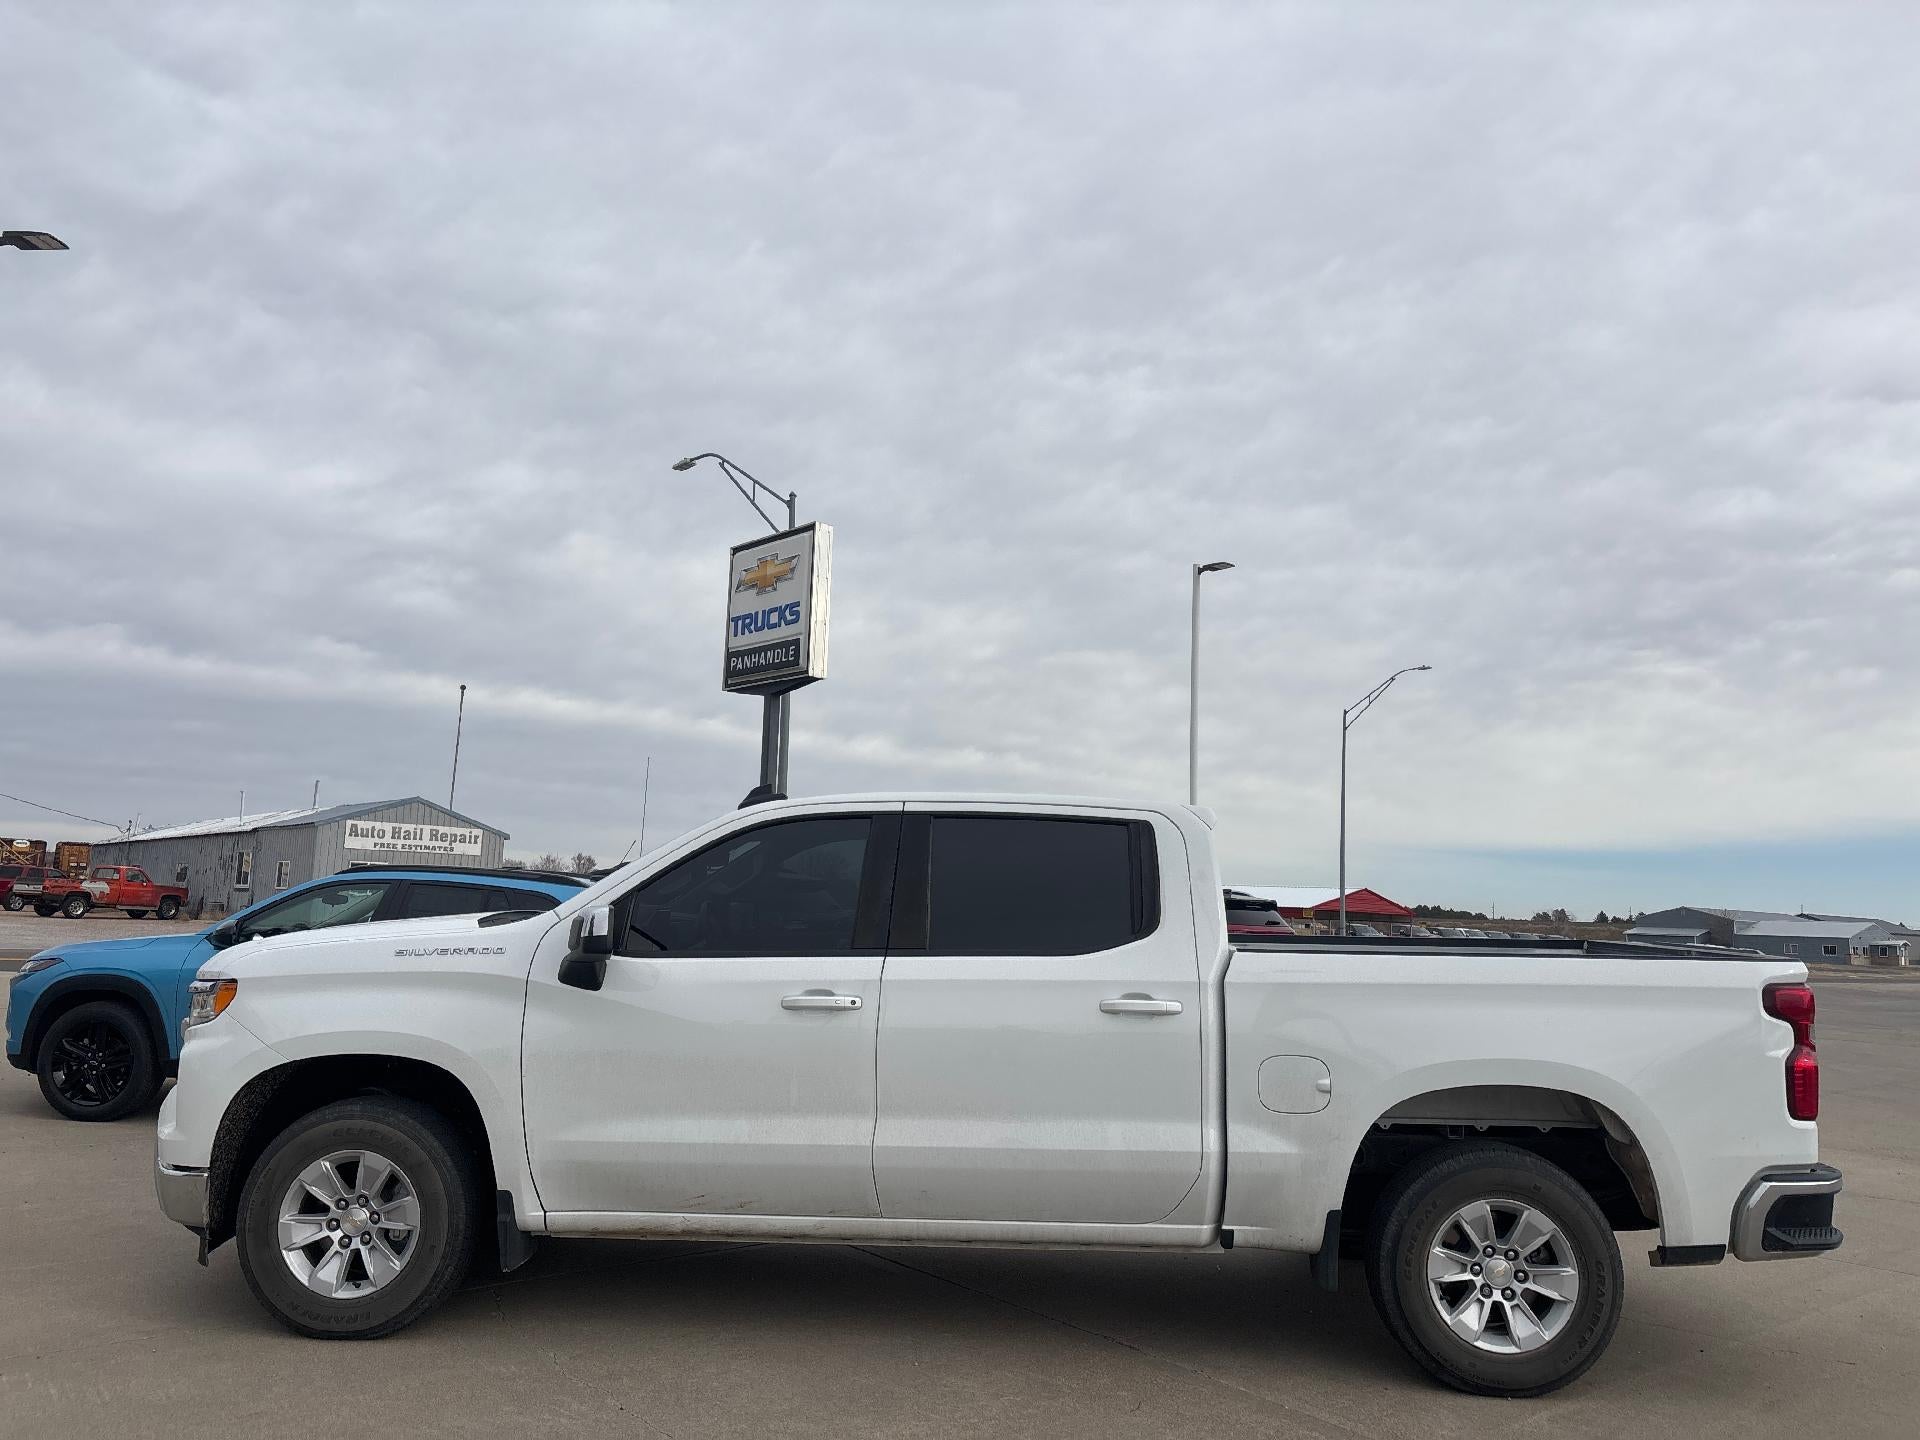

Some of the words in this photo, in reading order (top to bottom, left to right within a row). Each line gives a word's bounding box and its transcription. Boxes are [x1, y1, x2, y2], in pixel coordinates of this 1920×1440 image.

[731, 601, 801, 637] TRUCKS
[730, 645, 796, 671] PANHANDLE
[348, 823, 386, 839] Auto
[391, 826, 424, 841] Hail
[429, 828, 480, 846] Repair
[401, 843, 455, 852] ESTIMATES
[394, 947, 506, 957] SILVERADO
